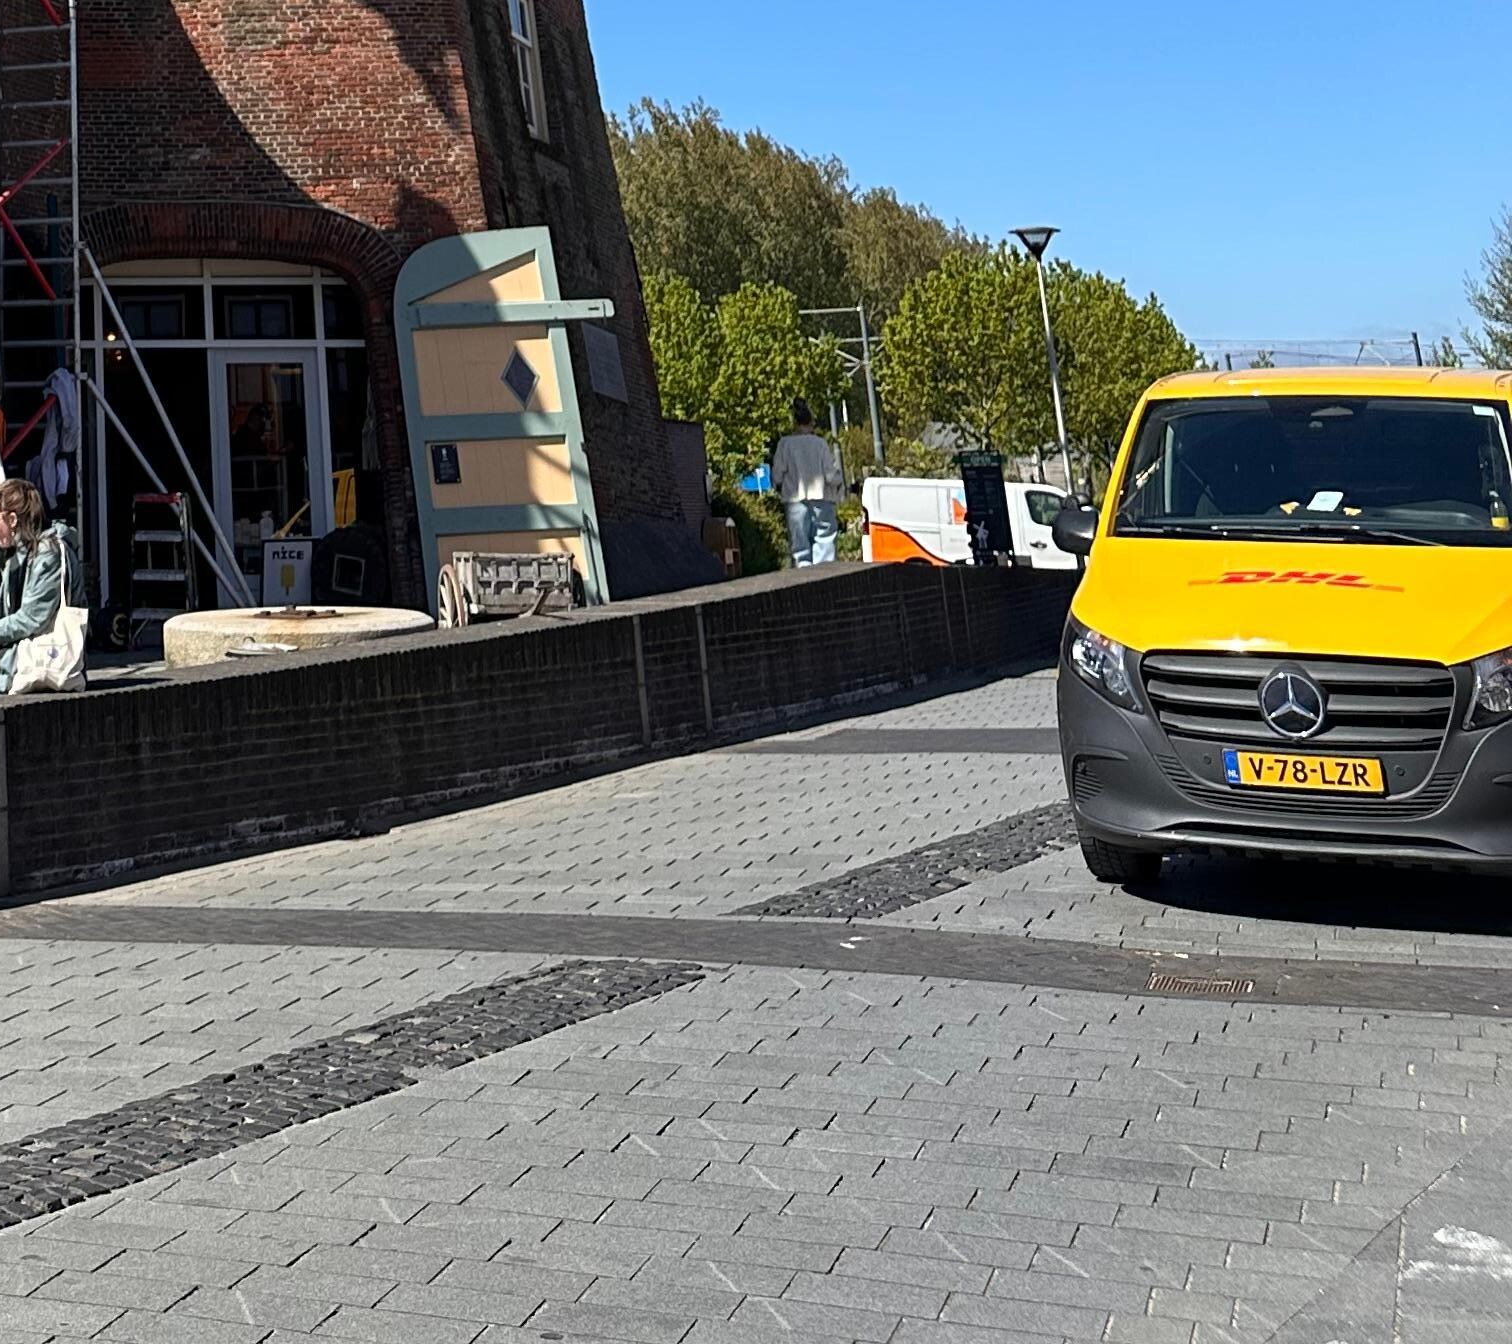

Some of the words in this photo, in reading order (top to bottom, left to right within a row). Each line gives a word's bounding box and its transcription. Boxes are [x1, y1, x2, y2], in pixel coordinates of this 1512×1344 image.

[1217, 571, 1373, 588] DHL
[1227, 769, 1239, 778] NL
[1248, 757, 1370, 787] V-78-LZR
